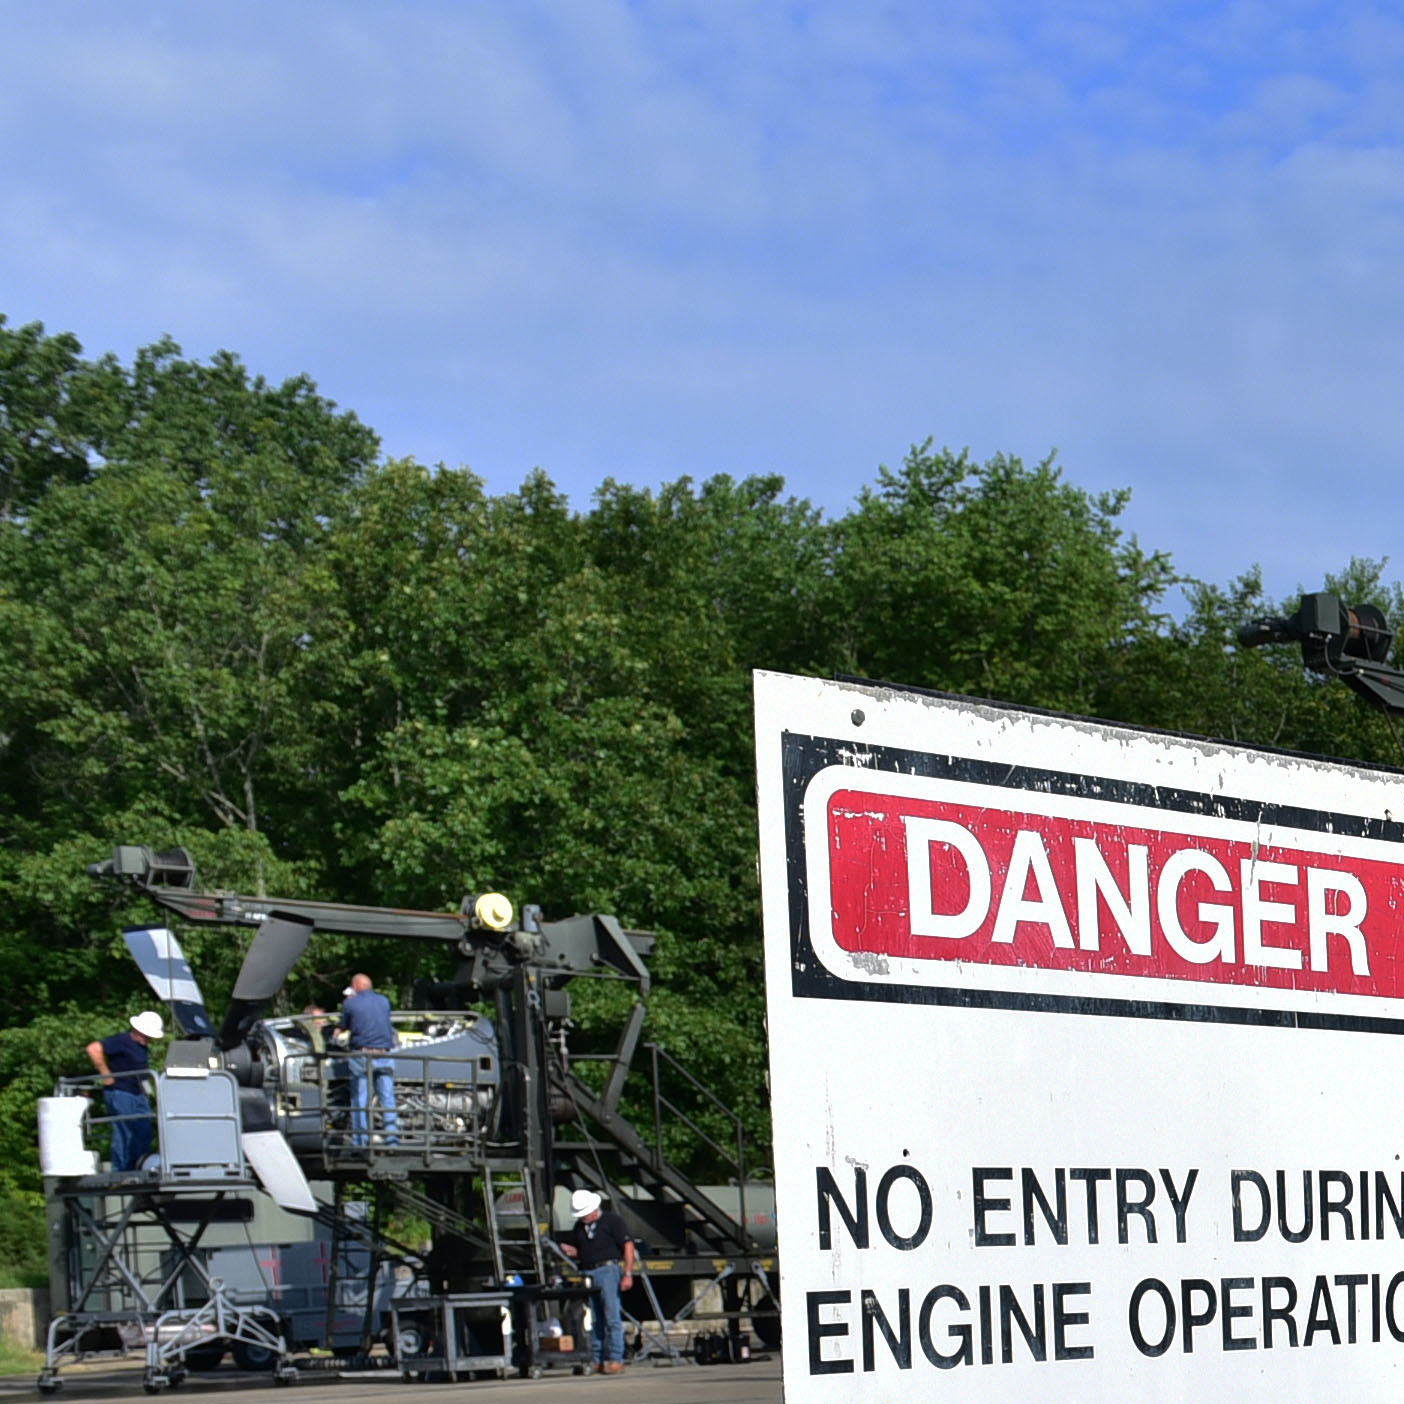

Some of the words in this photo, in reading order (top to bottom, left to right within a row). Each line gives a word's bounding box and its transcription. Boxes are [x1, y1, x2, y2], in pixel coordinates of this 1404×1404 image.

[903, 816, 1370, 976] DANGER
[816, 1165, 932, 1251] NO
[972, 1168, 1199, 1246] ENTRY
[806, 1282, 1094, 1375] ENGINE
